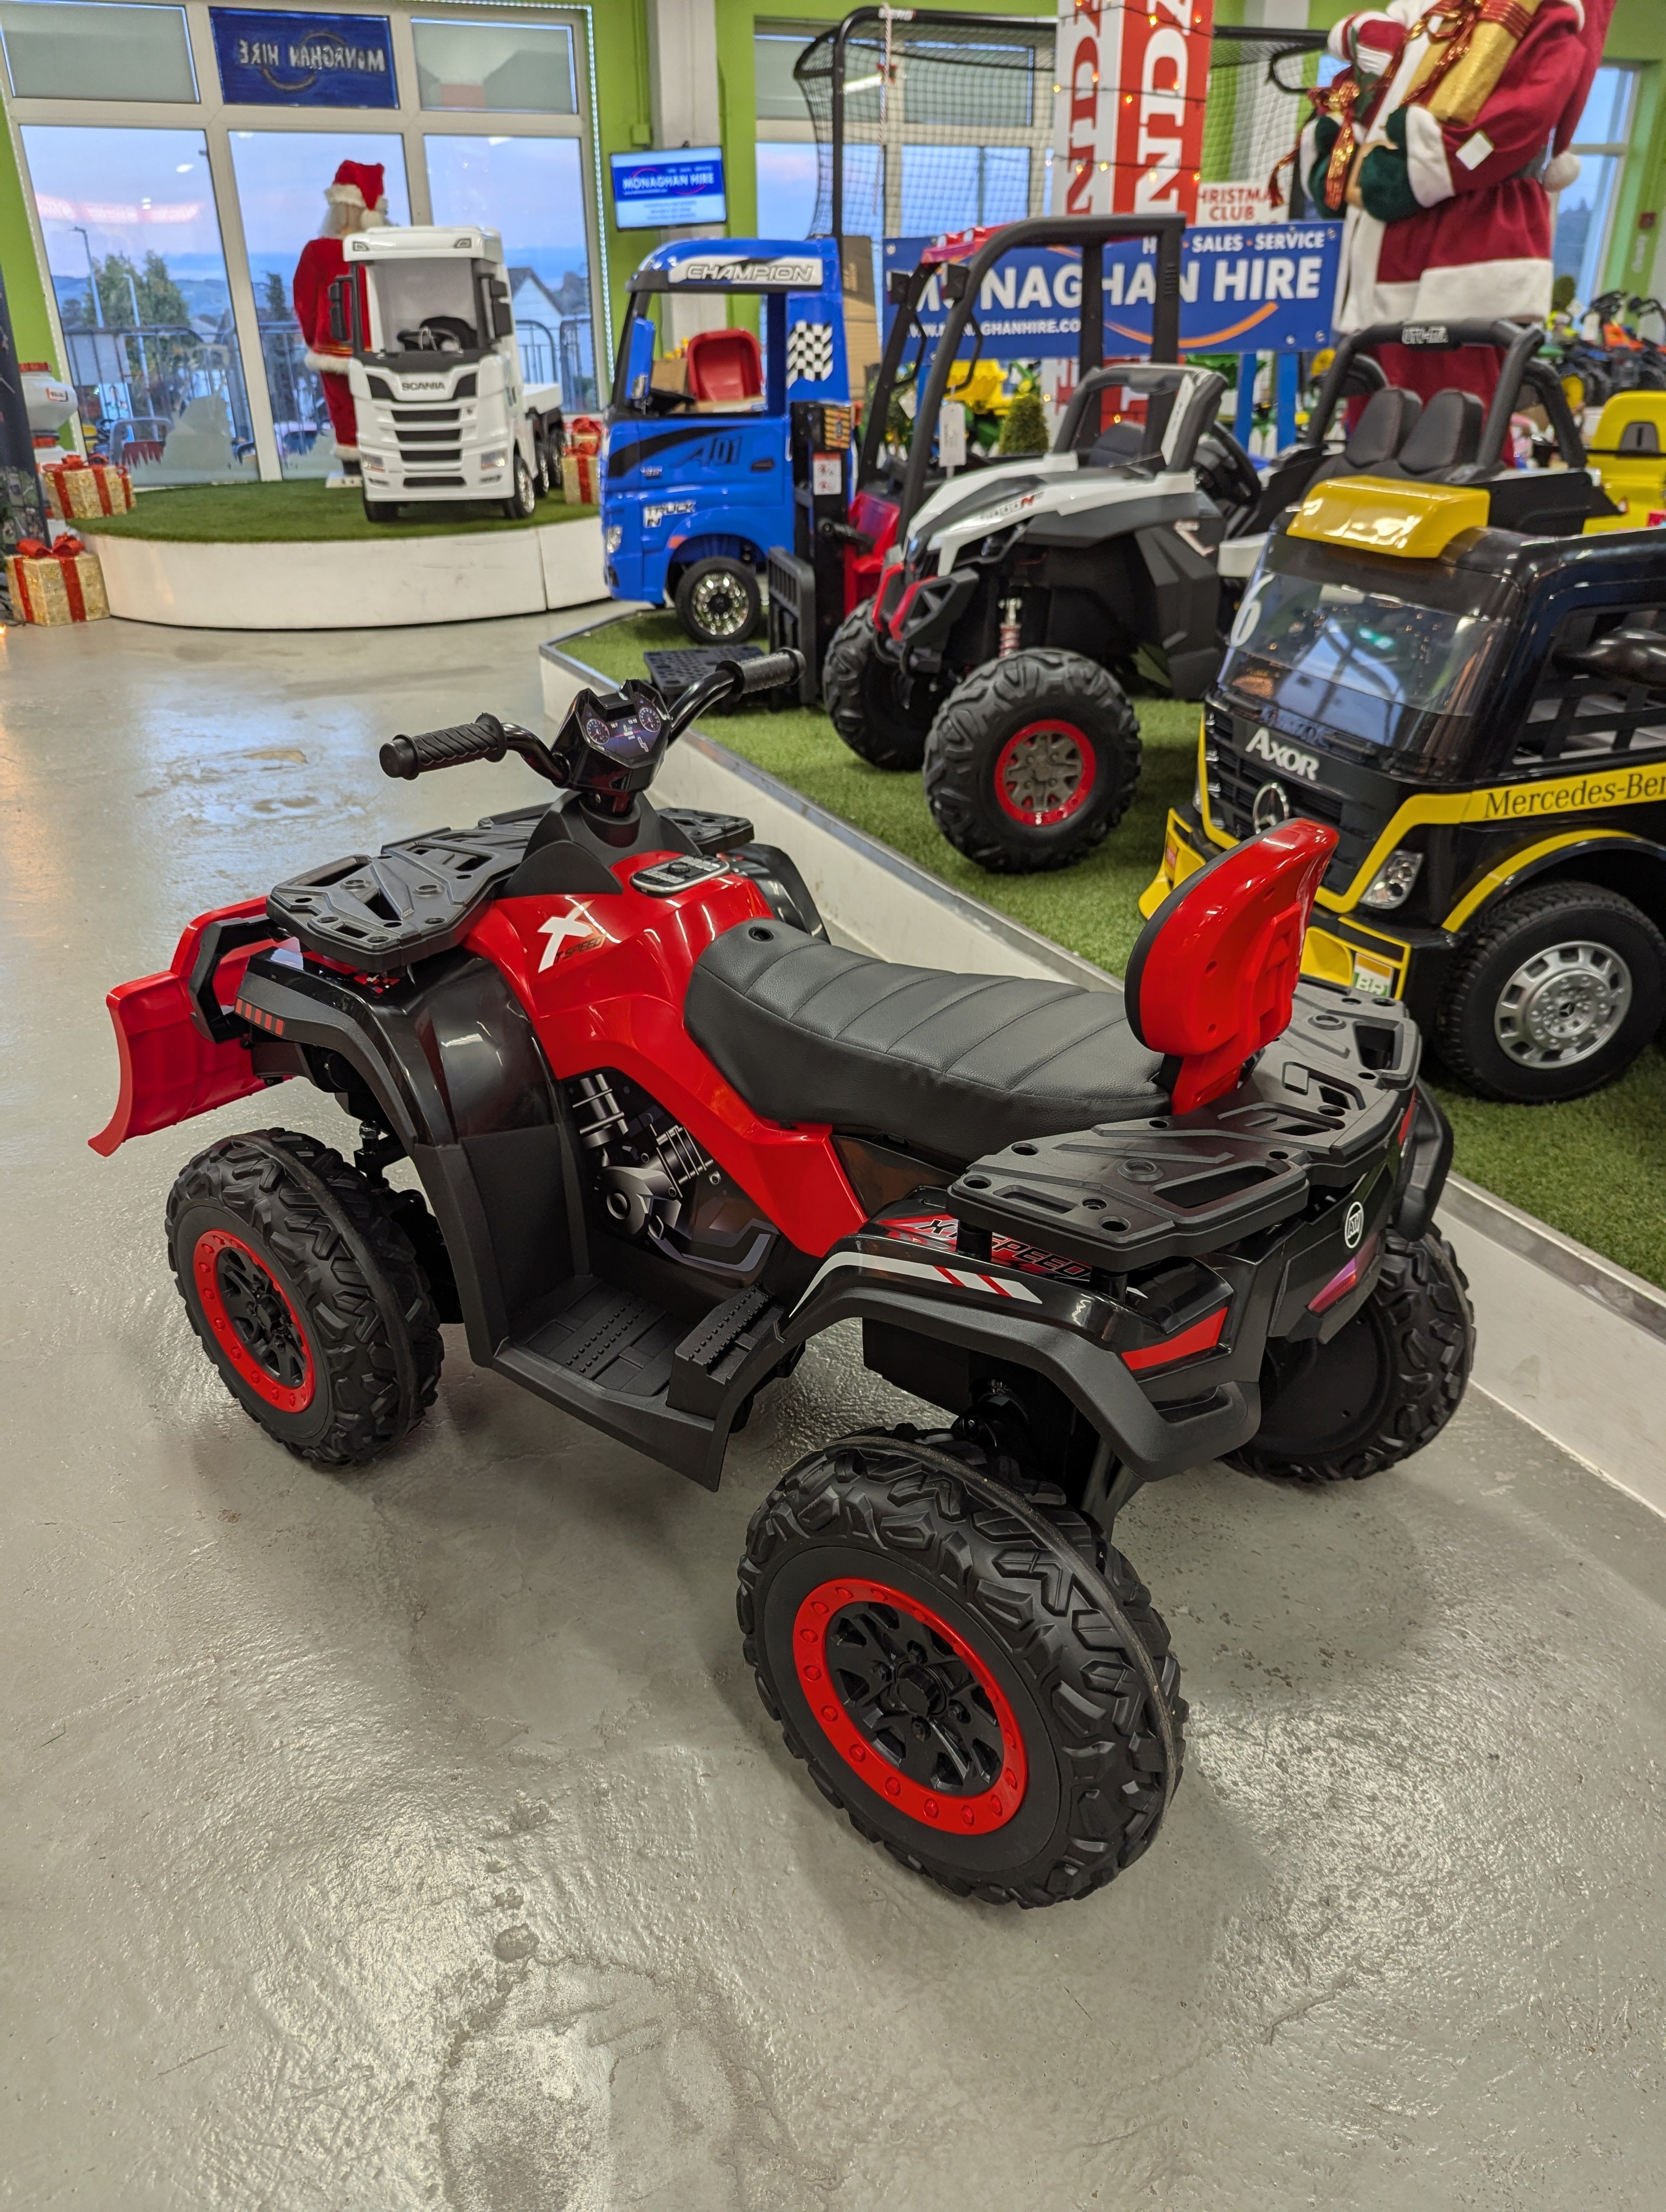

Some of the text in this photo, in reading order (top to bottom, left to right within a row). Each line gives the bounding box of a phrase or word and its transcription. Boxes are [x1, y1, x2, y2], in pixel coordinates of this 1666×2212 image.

[622, 173, 689, 190] MONAGHAN
[1209, 204, 1255, 222] CLUB
[1191, 230, 1325, 253] SALES SERVICE
[686, 263, 813, 282] CHAMPION
[1213, 256, 1323, 302] HIRE
[402, 382, 446, 391] SCANIA
[647, 500, 695, 517] TRUCK
[646, 518, 661, 528] IN
